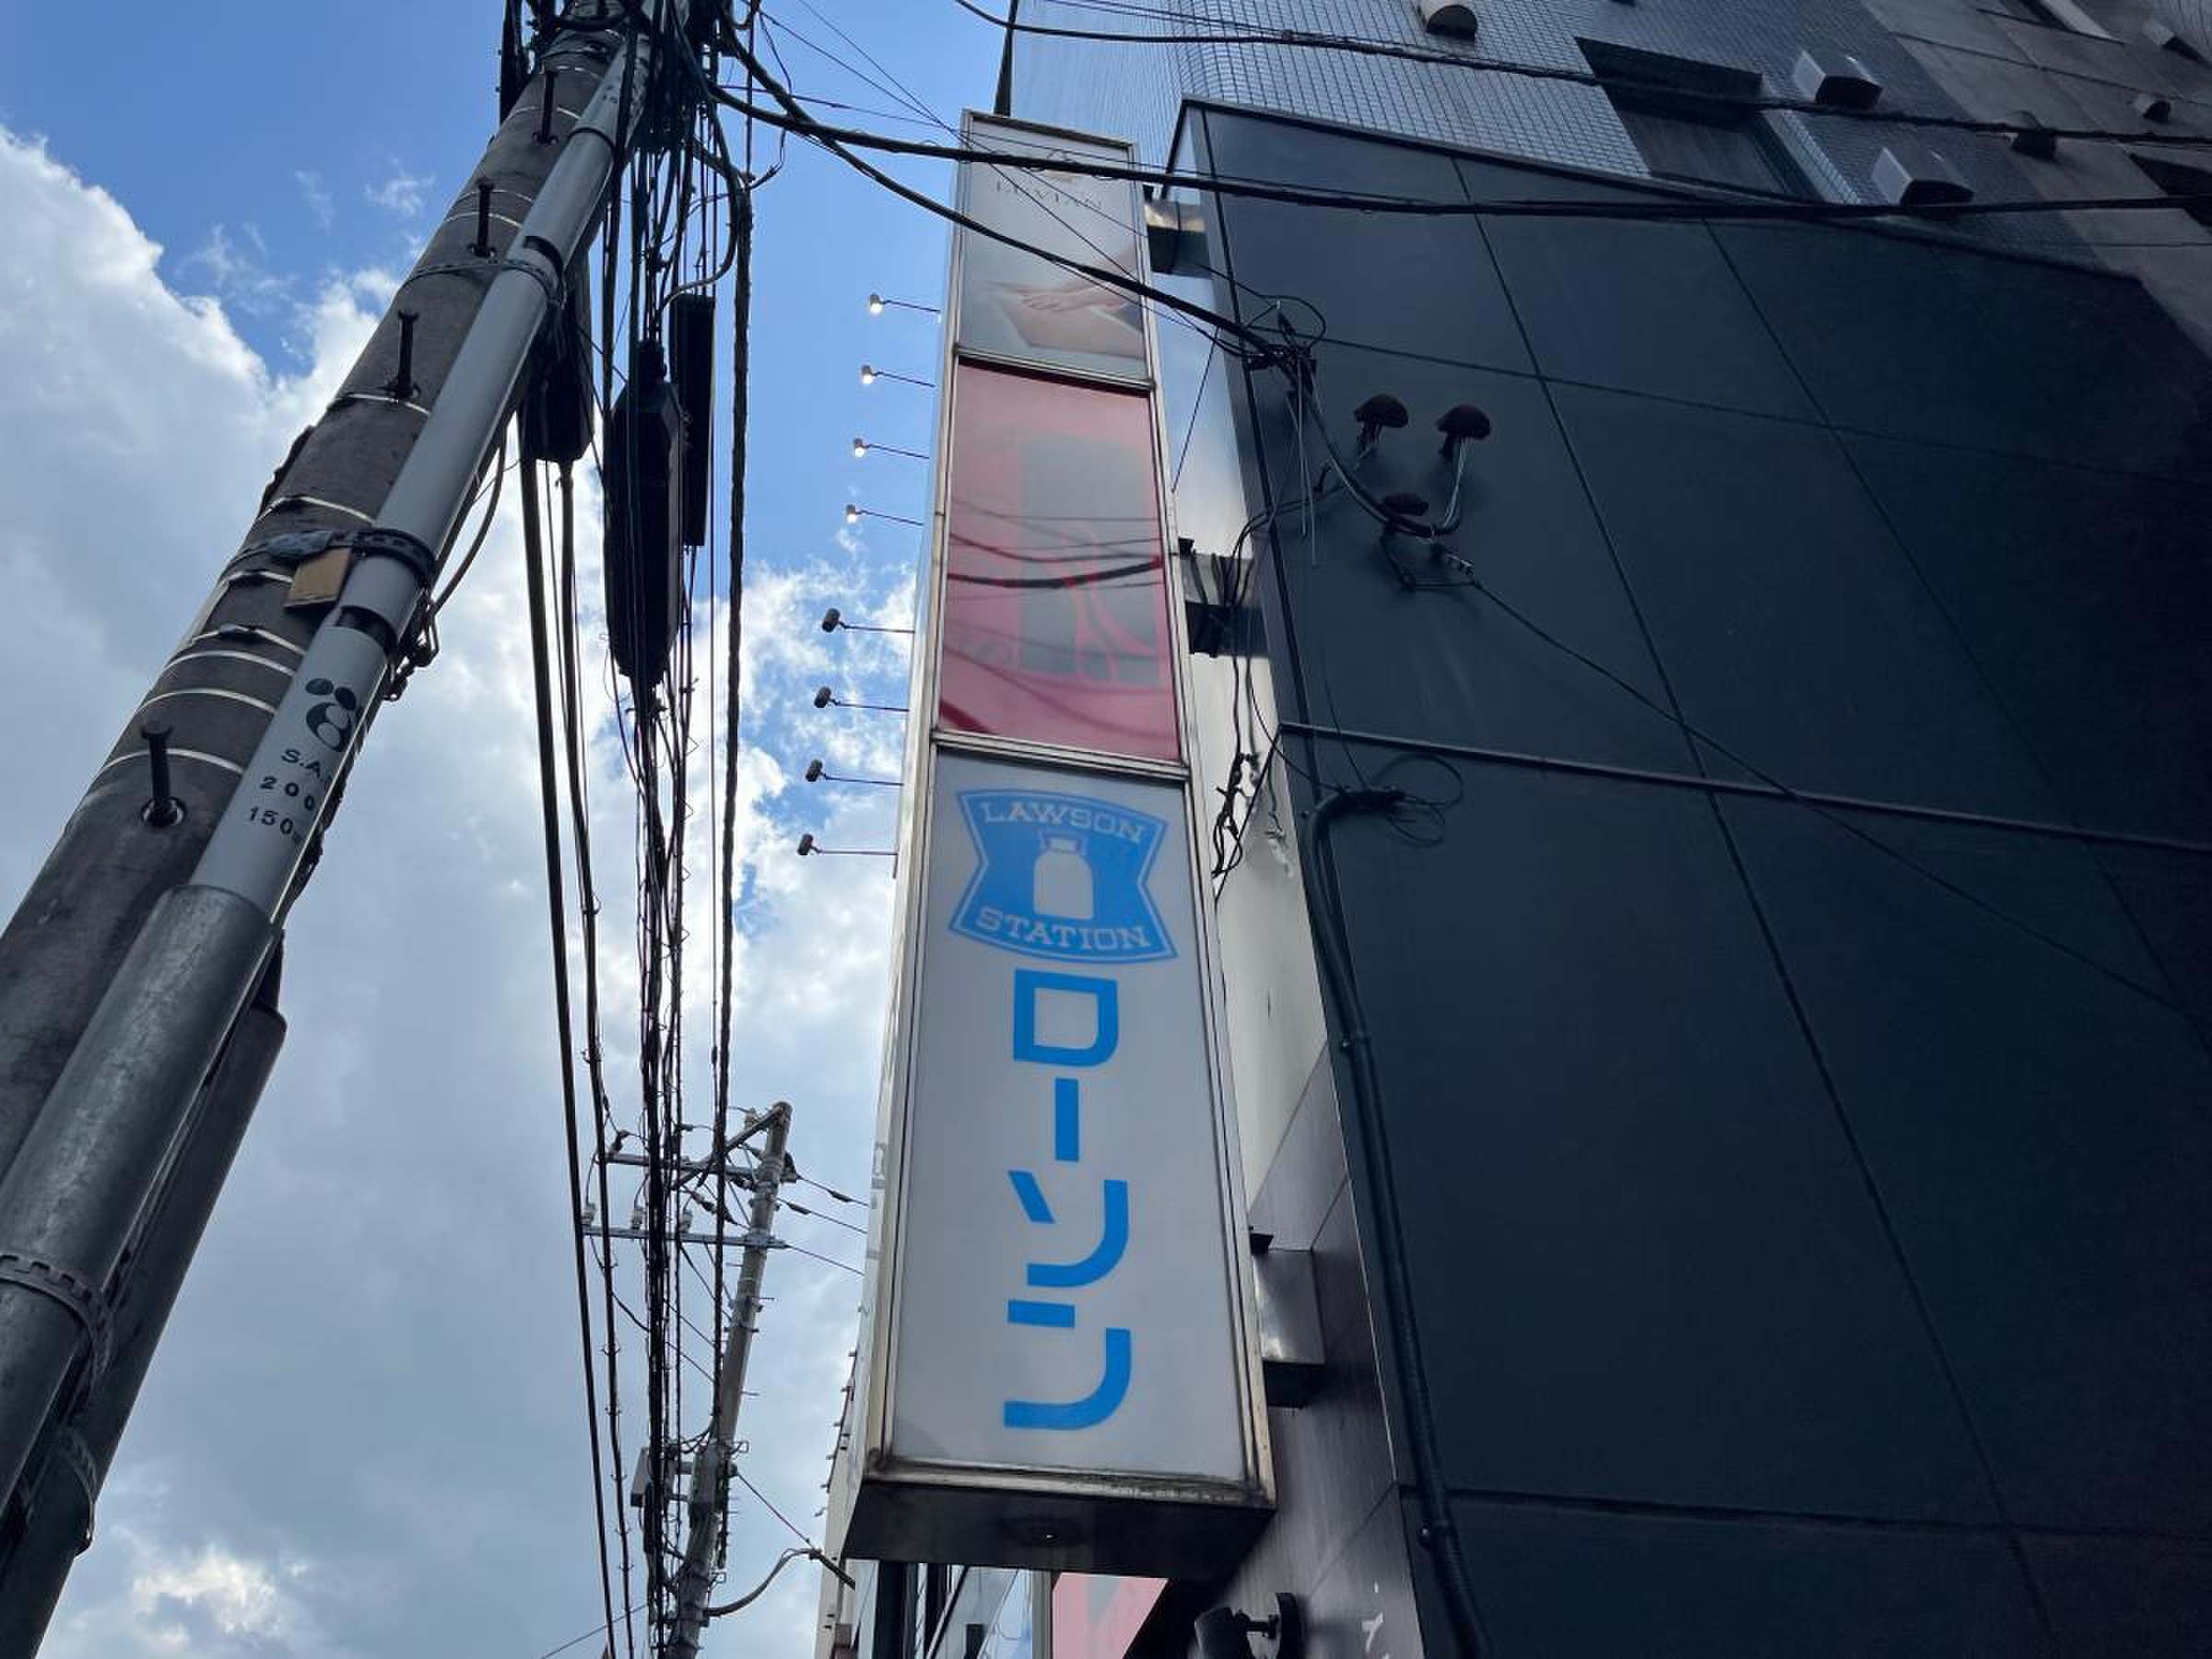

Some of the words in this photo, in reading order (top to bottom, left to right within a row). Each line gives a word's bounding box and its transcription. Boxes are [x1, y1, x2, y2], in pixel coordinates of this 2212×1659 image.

[979, 802, 1147, 845] LAWSON
[976, 907, 1151, 950] STATION
[1004, 968, 1132, 1431] ローソン
